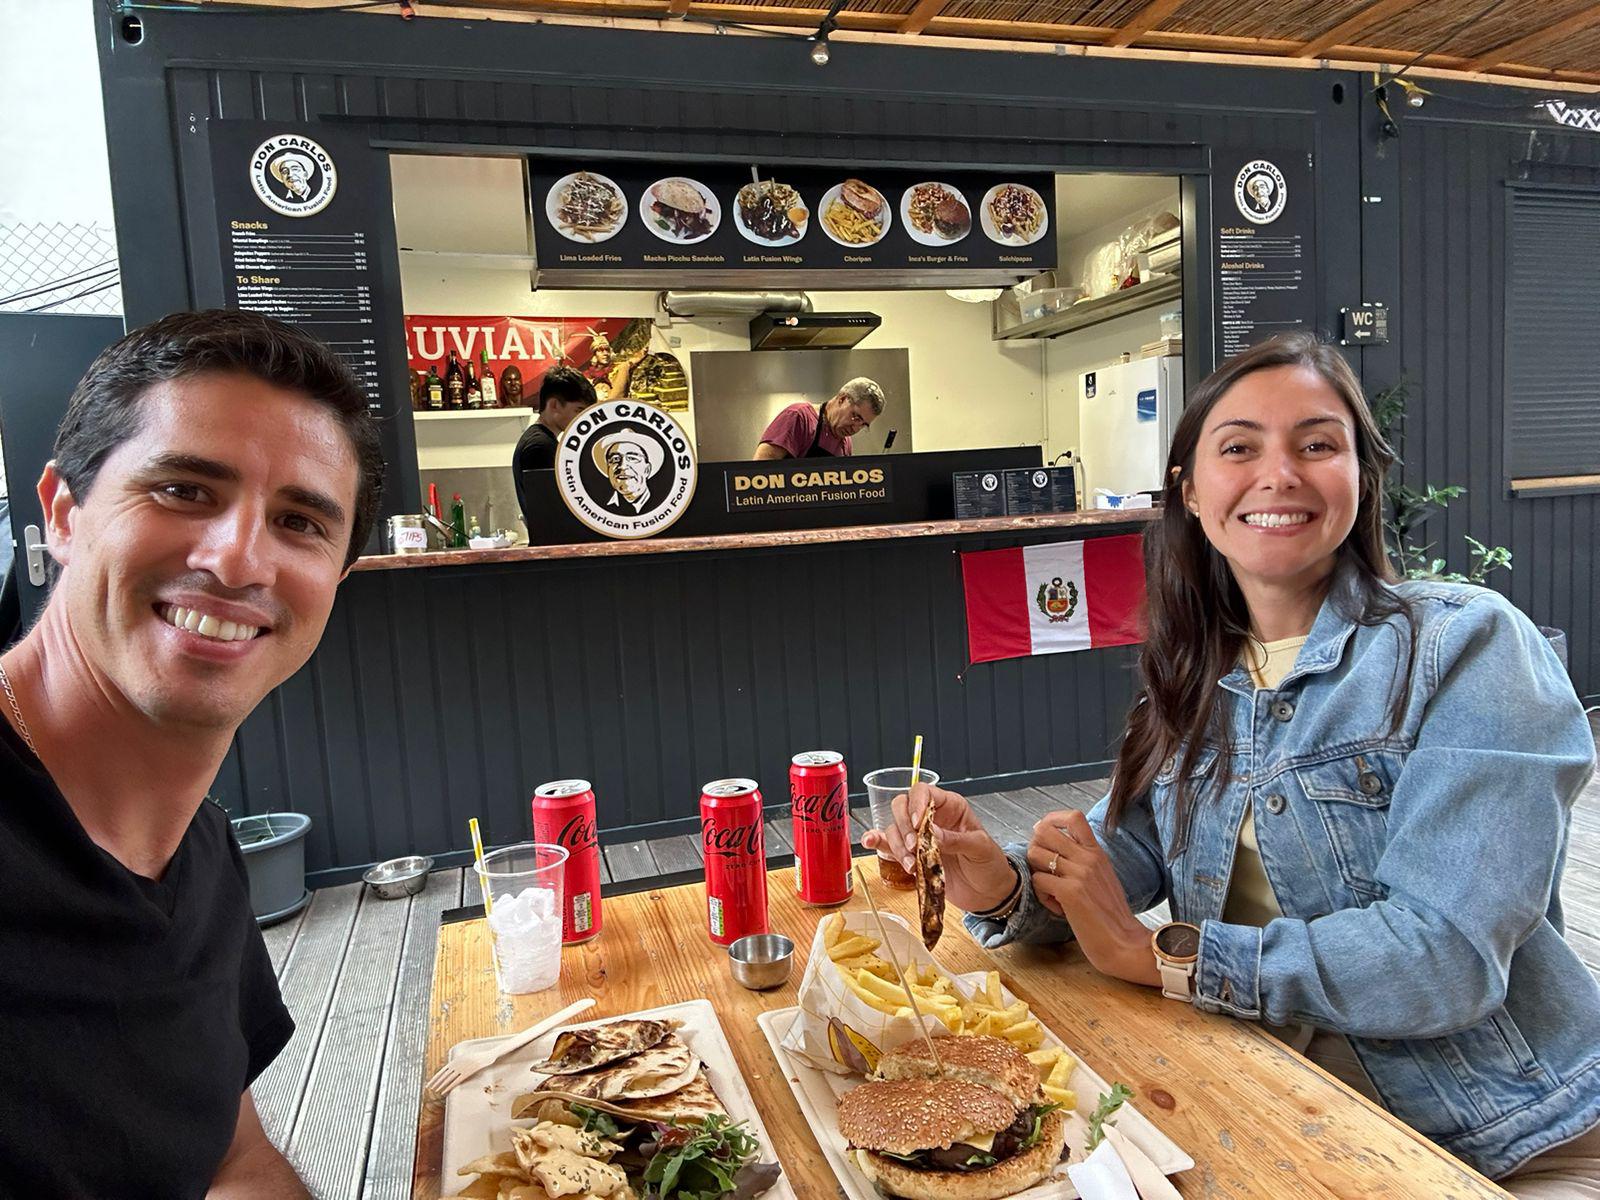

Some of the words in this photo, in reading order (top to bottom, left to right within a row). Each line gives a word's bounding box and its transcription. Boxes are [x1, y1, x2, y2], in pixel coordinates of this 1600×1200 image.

[254, 143, 276, 170] DON
[278, 138, 332, 172] CARLOS
[1238, 167, 1251, 188] DON
[1253, 163, 1285, 190] CARLOS
[255, 174, 286, 195] Latin
[231, 220, 268, 230] Snacks
[1220, 227, 1235, 235] Soft
[1235, 227, 1255, 235] Drinks
[559, 254, 577, 262] Lima
[578, 254, 604, 262] Loaded
[605, 254, 622, 262] Fries
[644, 254, 667, 262] Machu
[668, 254, 691, 262] Picchu
[692, 254, 725, 262] Sandwich
[783, 255, 803, 265] Wings
[844, 255, 872, 264] Choripan
[908, 255, 926, 263] Inca's
[927, 255, 947, 265] Burger
[948, 255, 953, 263] &
[954, 255, 969, 263] Fries
[998, 255, 1033, 265] Salchipapas
[236, 276, 249, 284] To
[250, 276, 281, 284] Share
[1352, 312, 1373, 325] WC
[405, 326, 562, 361] UVIAN
[566, 408, 608, 453] DON
[615, 404, 690, 471] CARLOS
[735, 473, 785, 491] DON
[791, 468, 885, 488] CARLOS
[565, 459, 576, 493] Latin
[574, 495, 630, 530] American
[632, 508, 672, 530] Fusion
[671, 477, 688, 507] Food
[736, 496, 763, 506] Latin
[767, 491, 818, 504] American
[821, 489, 857, 502] Fusion
[859, 487, 886, 499] Food
